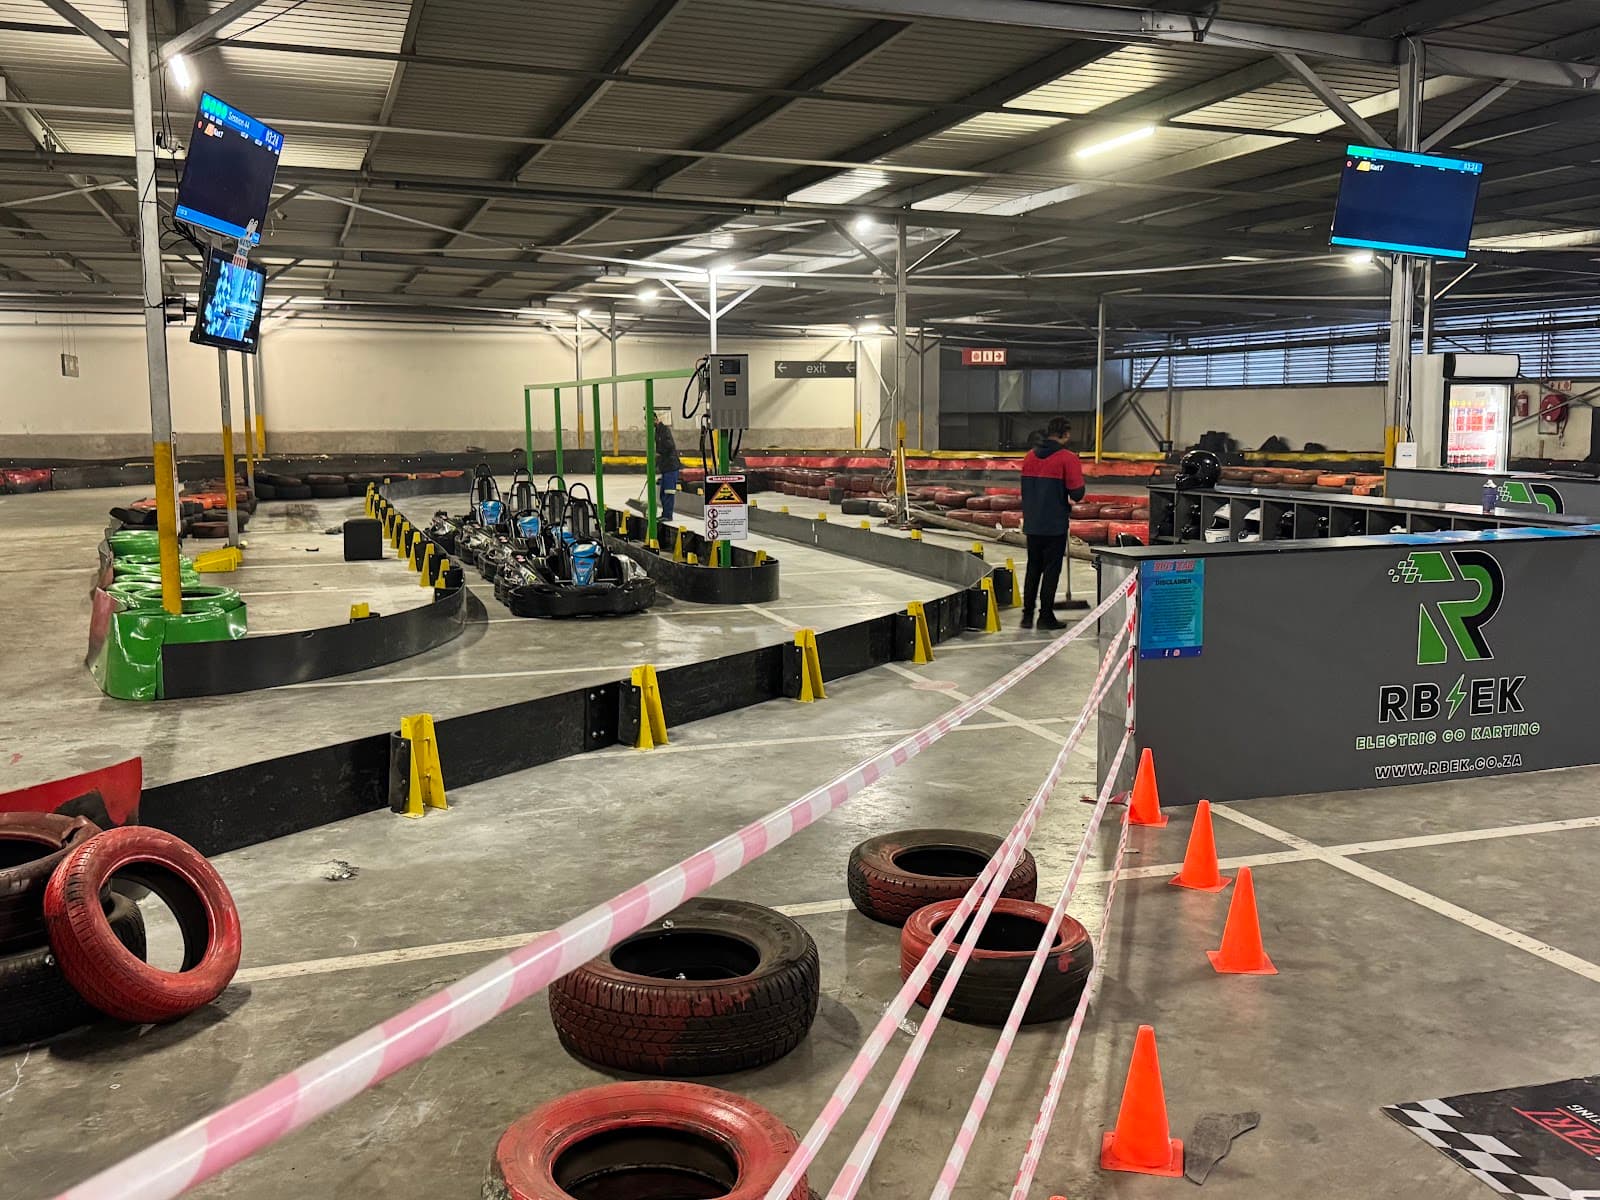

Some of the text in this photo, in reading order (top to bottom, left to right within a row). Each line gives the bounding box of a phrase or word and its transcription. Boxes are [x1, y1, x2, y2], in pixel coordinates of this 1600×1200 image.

[806, 361, 827, 374] exit
[1355, 721, 1541, 750] ELECTRIC GO KARTING
[1374, 753, 1522, 780] WWW.RBEK.CO.ZA
